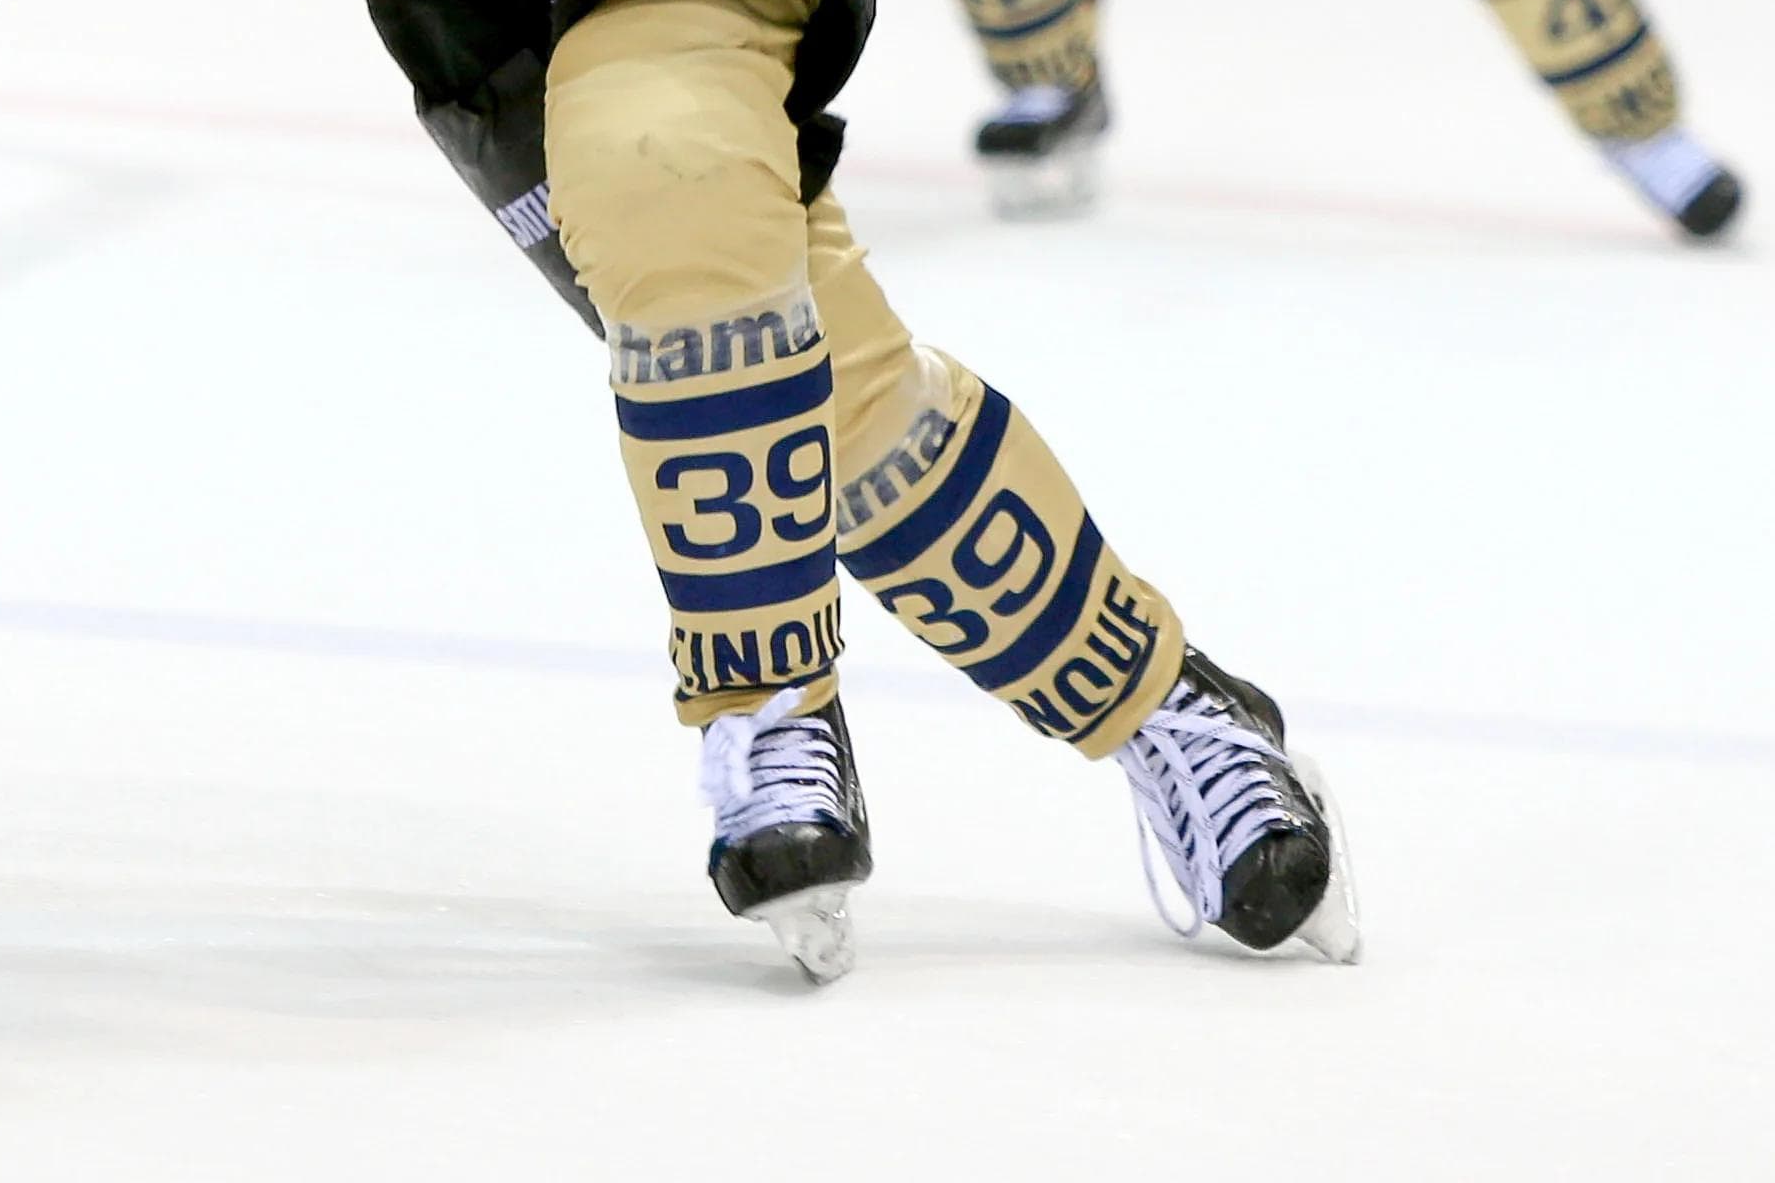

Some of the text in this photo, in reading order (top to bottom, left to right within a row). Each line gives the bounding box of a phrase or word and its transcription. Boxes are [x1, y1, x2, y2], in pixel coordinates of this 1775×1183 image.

[620, 302, 822, 384] hama
[656, 424, 835, 560] 39
[877, 487, 1056, 655] 39
